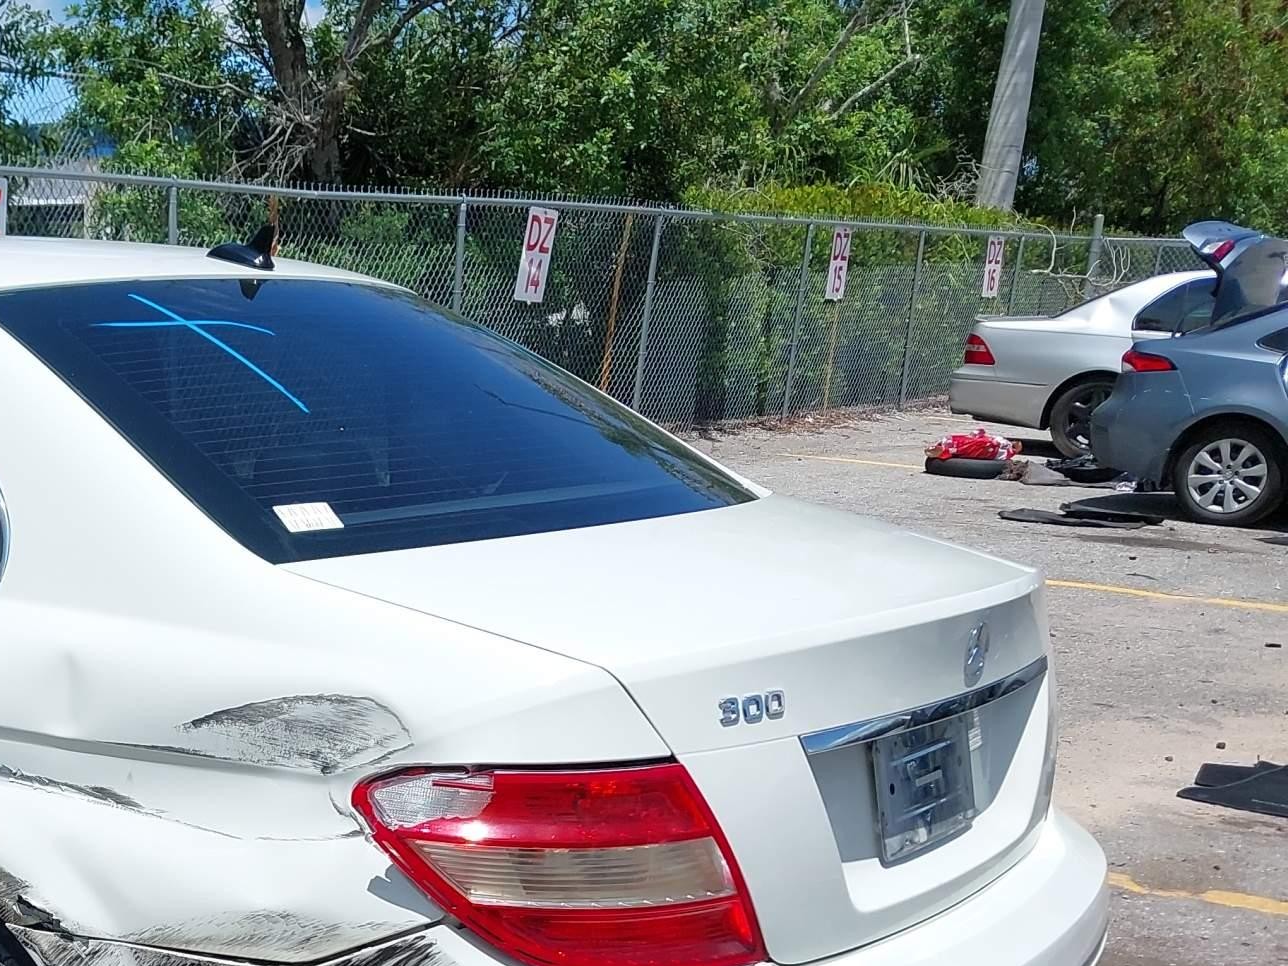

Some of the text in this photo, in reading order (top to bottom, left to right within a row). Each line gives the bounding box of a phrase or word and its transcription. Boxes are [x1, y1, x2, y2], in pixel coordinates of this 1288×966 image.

[525, 213, 556, 255] DZ
[832, 232, 850, 261] DZ
[987, 240, 1003, 265] DZ
[524, 257, 543, 295] 14
[831, 265, 844, 293] 15
[986, 268, 997, 292] 16
[718, 689, 786, 728] 300
